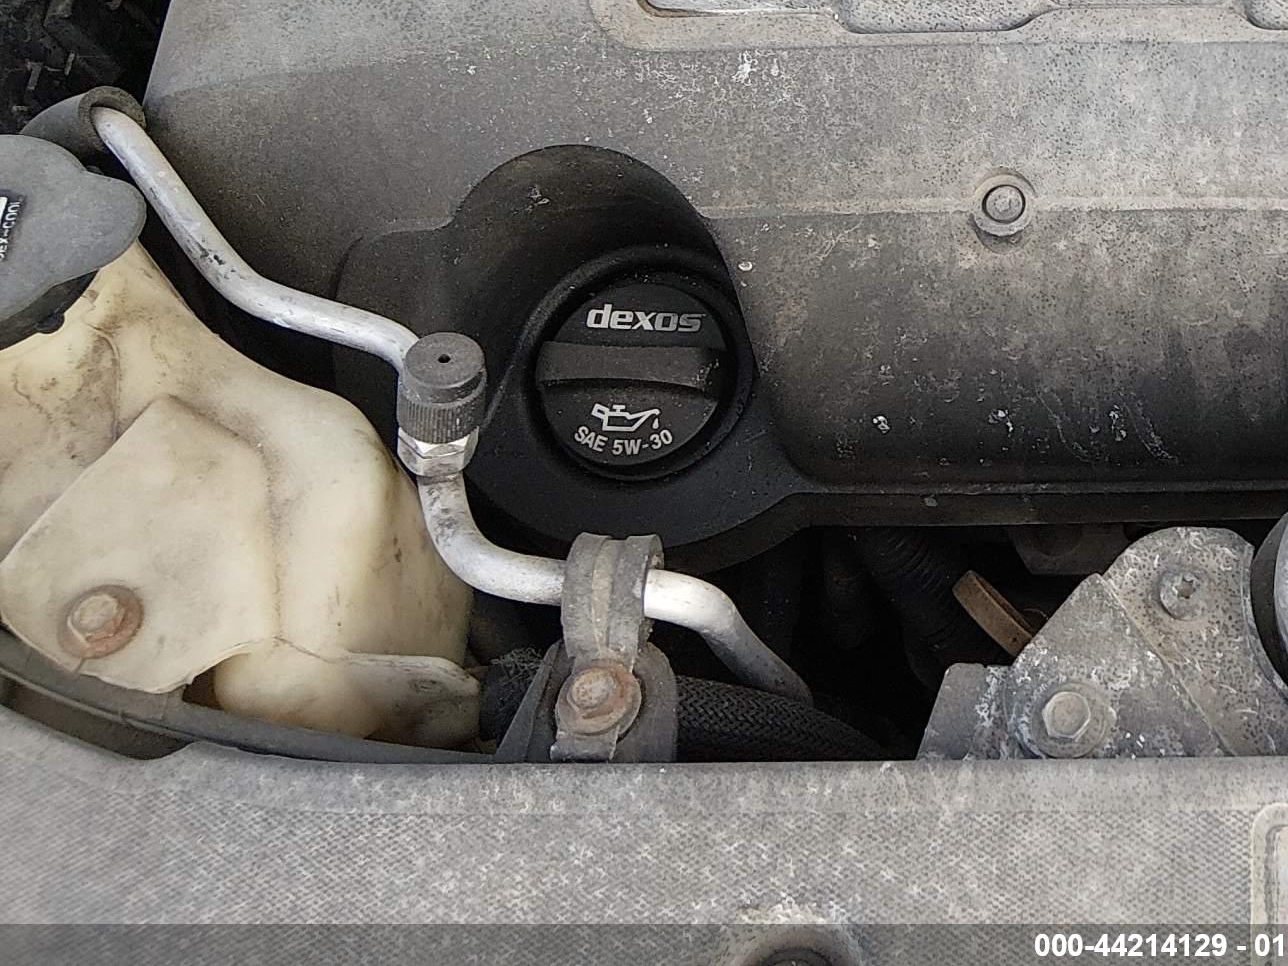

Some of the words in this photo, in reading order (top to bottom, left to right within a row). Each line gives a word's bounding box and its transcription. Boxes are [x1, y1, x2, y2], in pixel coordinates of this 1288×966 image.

[586, 303, 706, 333] dexos
[574, 425, 609, 453] SAE
[612, 429, 673, 456] 5W-30
